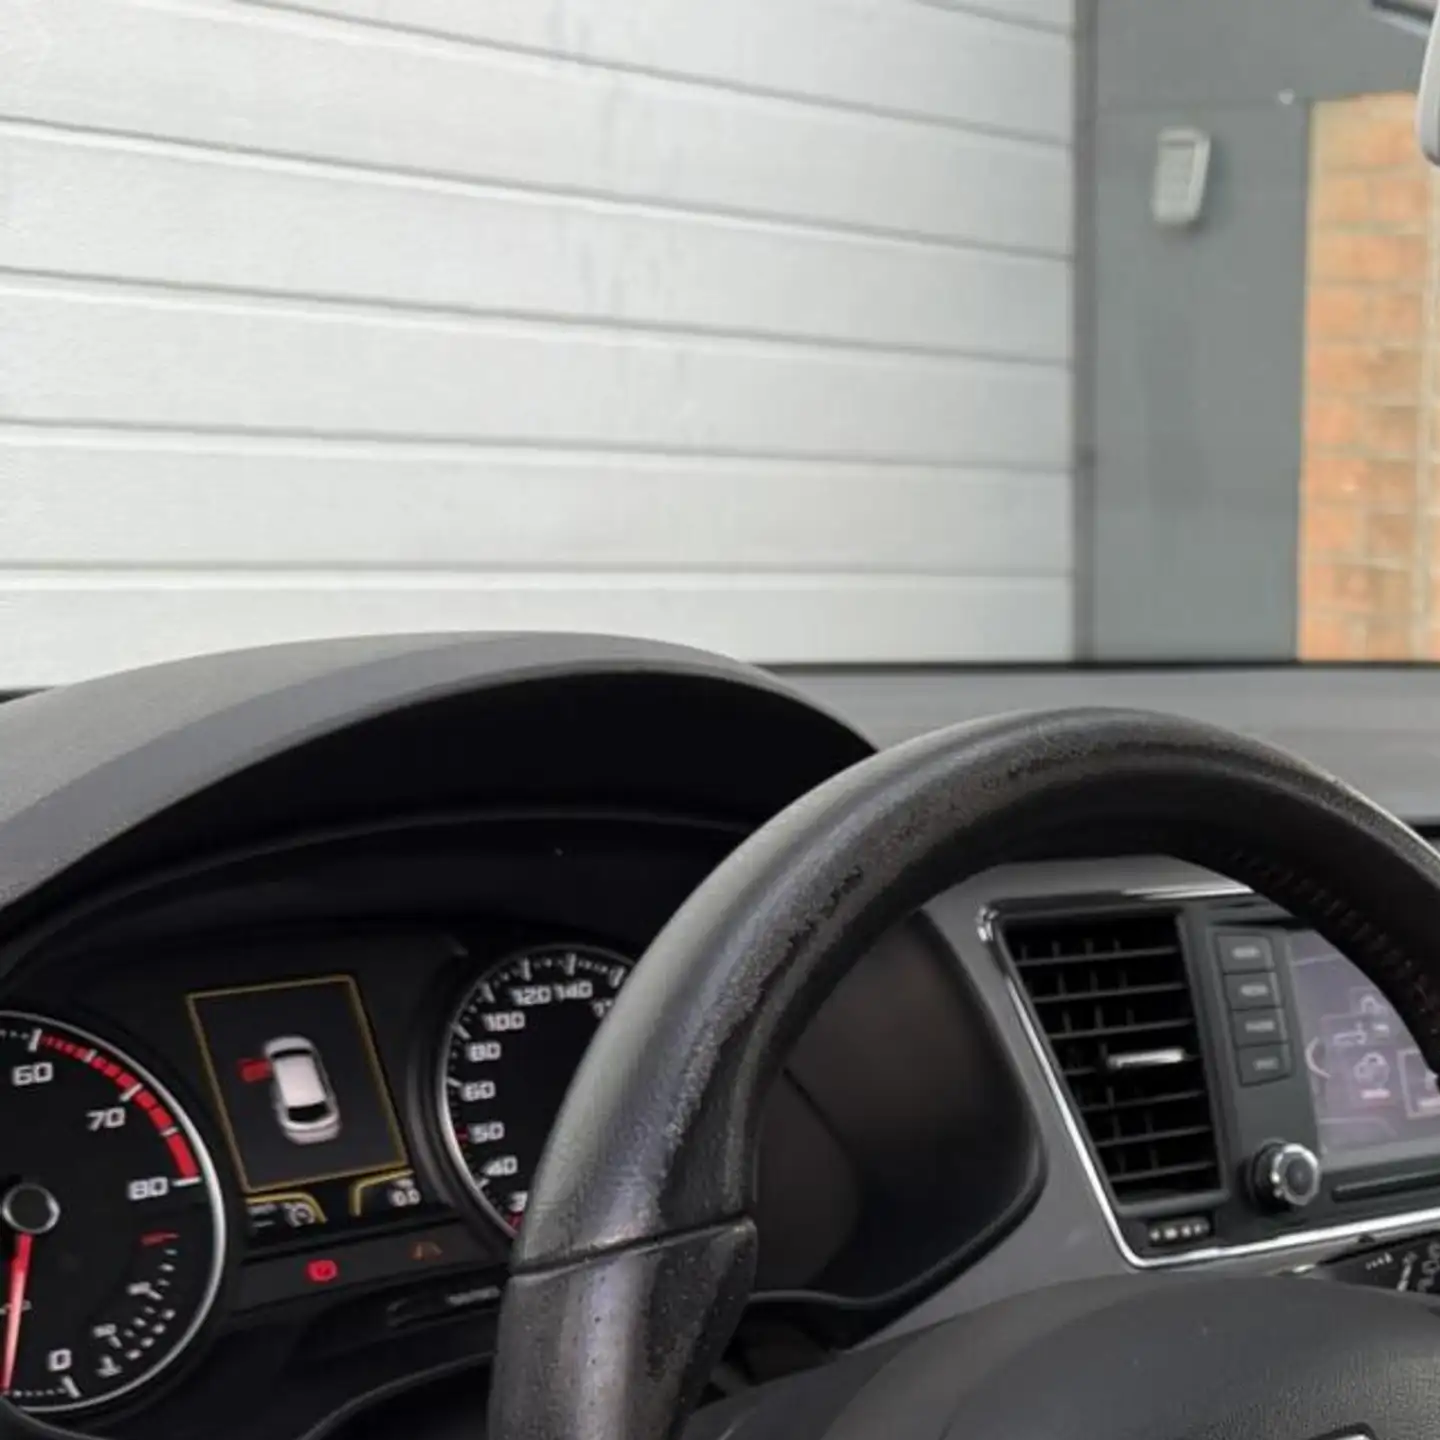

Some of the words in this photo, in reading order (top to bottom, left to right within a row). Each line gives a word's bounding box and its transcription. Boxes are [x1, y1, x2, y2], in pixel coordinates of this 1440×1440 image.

[511, 985, 551, 1006] 120
[483, 1011, 526, 1032] 100
[467, 1041, 501, 1063] 80
[12, 1062, 54, 1086] 60
[463, 1080, 496, 1102] 60
[86, 1107, 125, 1131] 70
[469, 1121, 505, 1144] 50
[483, 1155, 518, 1176] 40
[128, 1177, 168, 1201] 80
[47, 1348, 72, 1371] 0
